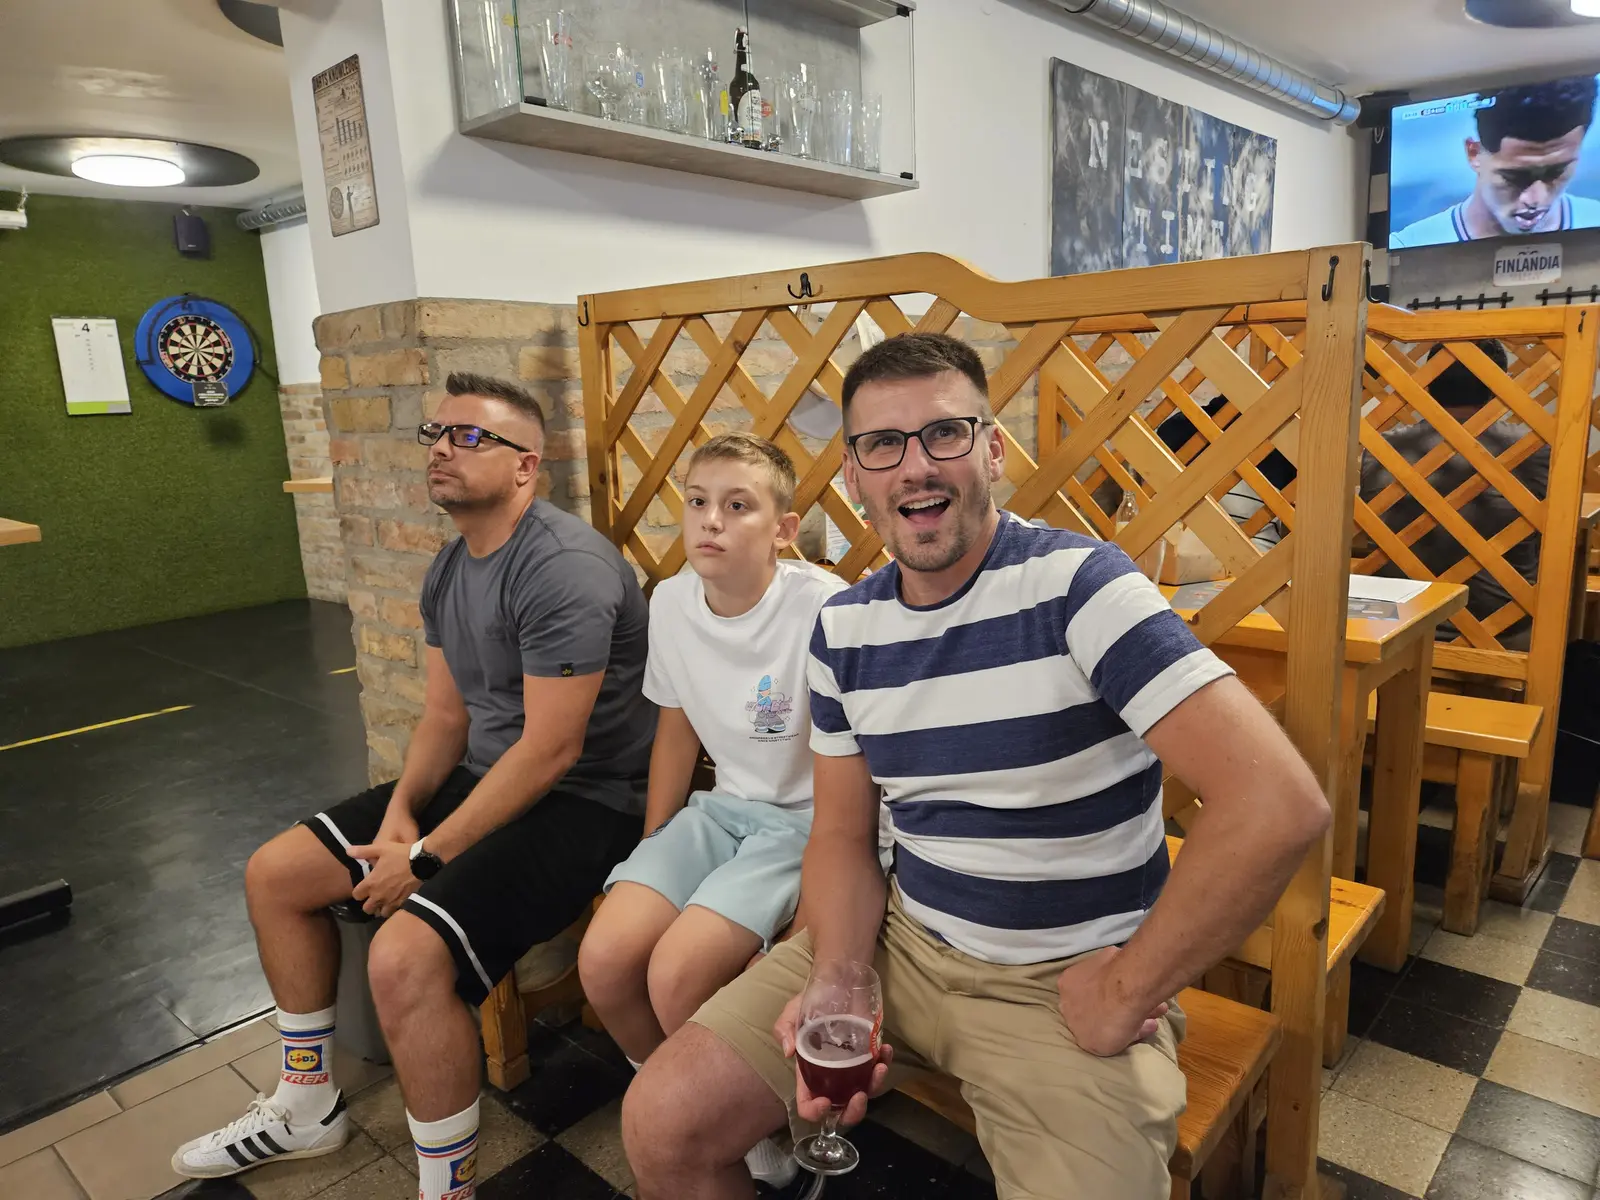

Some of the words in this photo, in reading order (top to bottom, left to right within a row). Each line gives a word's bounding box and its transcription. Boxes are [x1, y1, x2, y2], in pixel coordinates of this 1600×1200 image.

[1087, 117, 1258, 213] NESTING
[1133, 206, 1225, 259] TIME
[1495, 255, 1560, 274] FINLANDIA
[81, 323, 90, 333] 4
[281, 1072, 328, 1085] TREK
